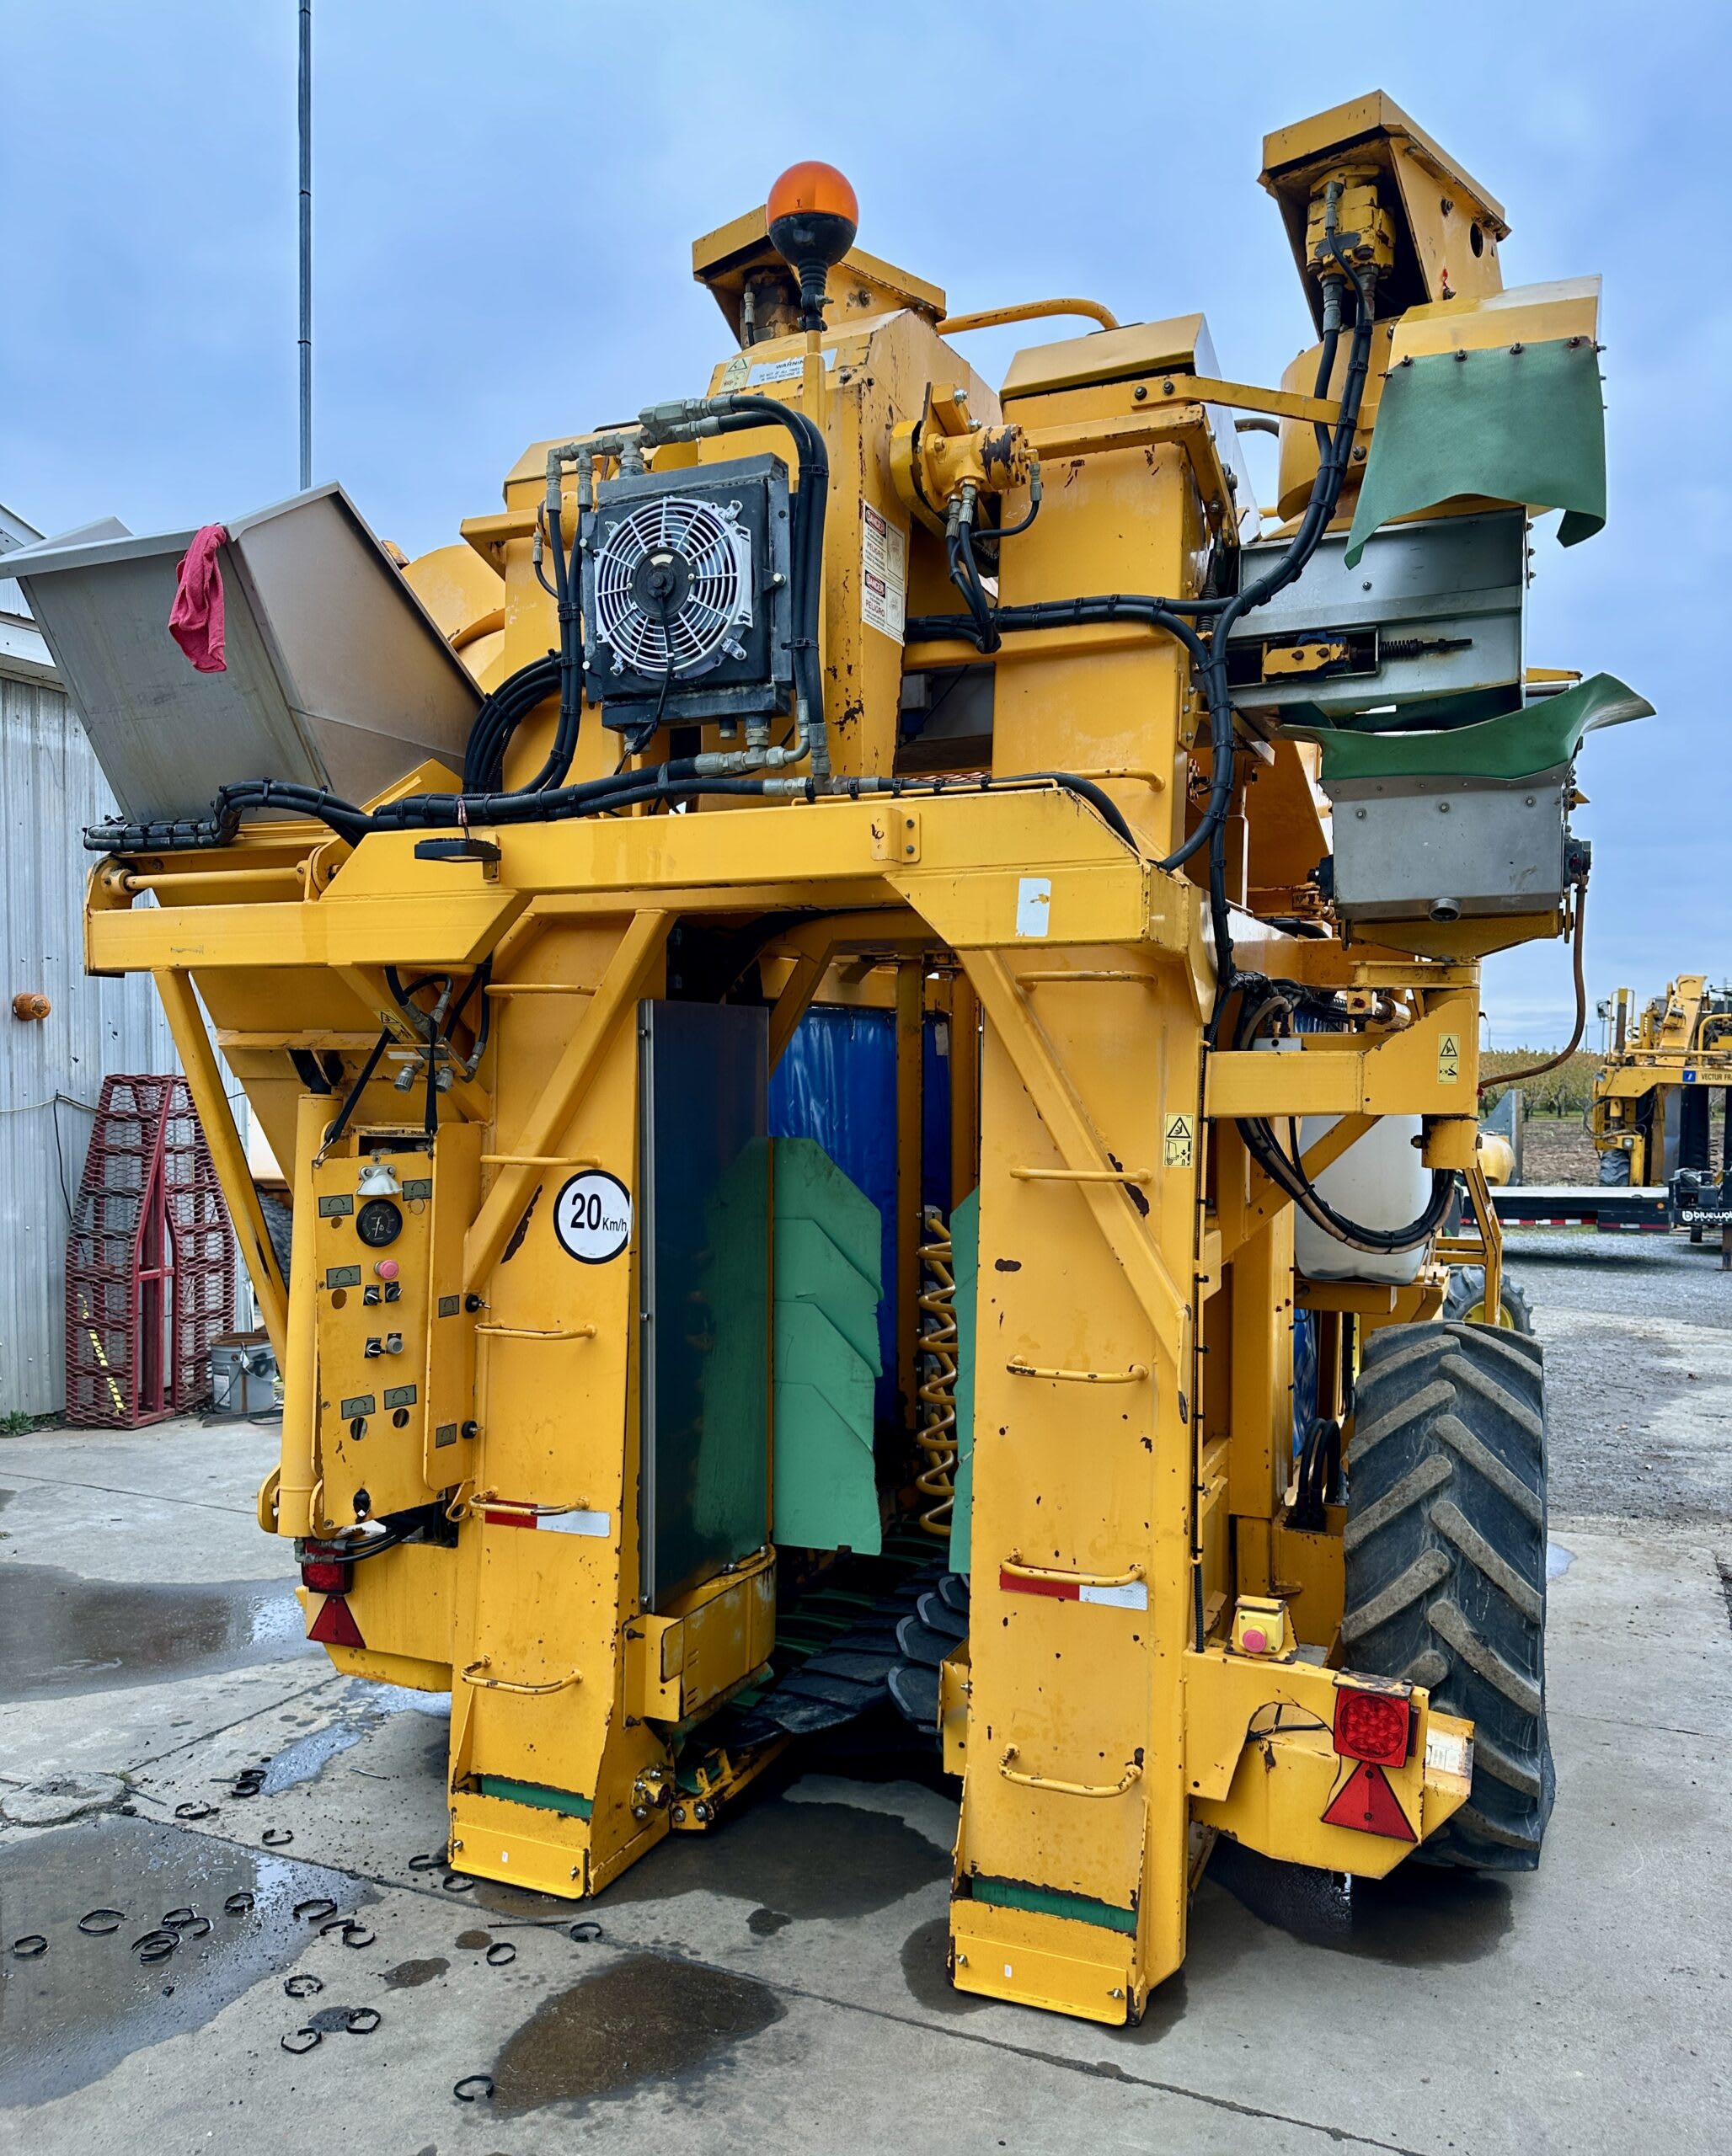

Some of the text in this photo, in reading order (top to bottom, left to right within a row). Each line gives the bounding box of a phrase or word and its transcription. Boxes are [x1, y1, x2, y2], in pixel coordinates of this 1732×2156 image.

[776, 360, 803, 369] WARNI
[867, 511, 885, 534] DANGER
[866, 542, 884, 560] PELIGRO
[867, 574, 885, 595] DANGER
[865, 599, 885, 617] PELIGRO
[570, 1193, 627, 1231] 20 Km/h
